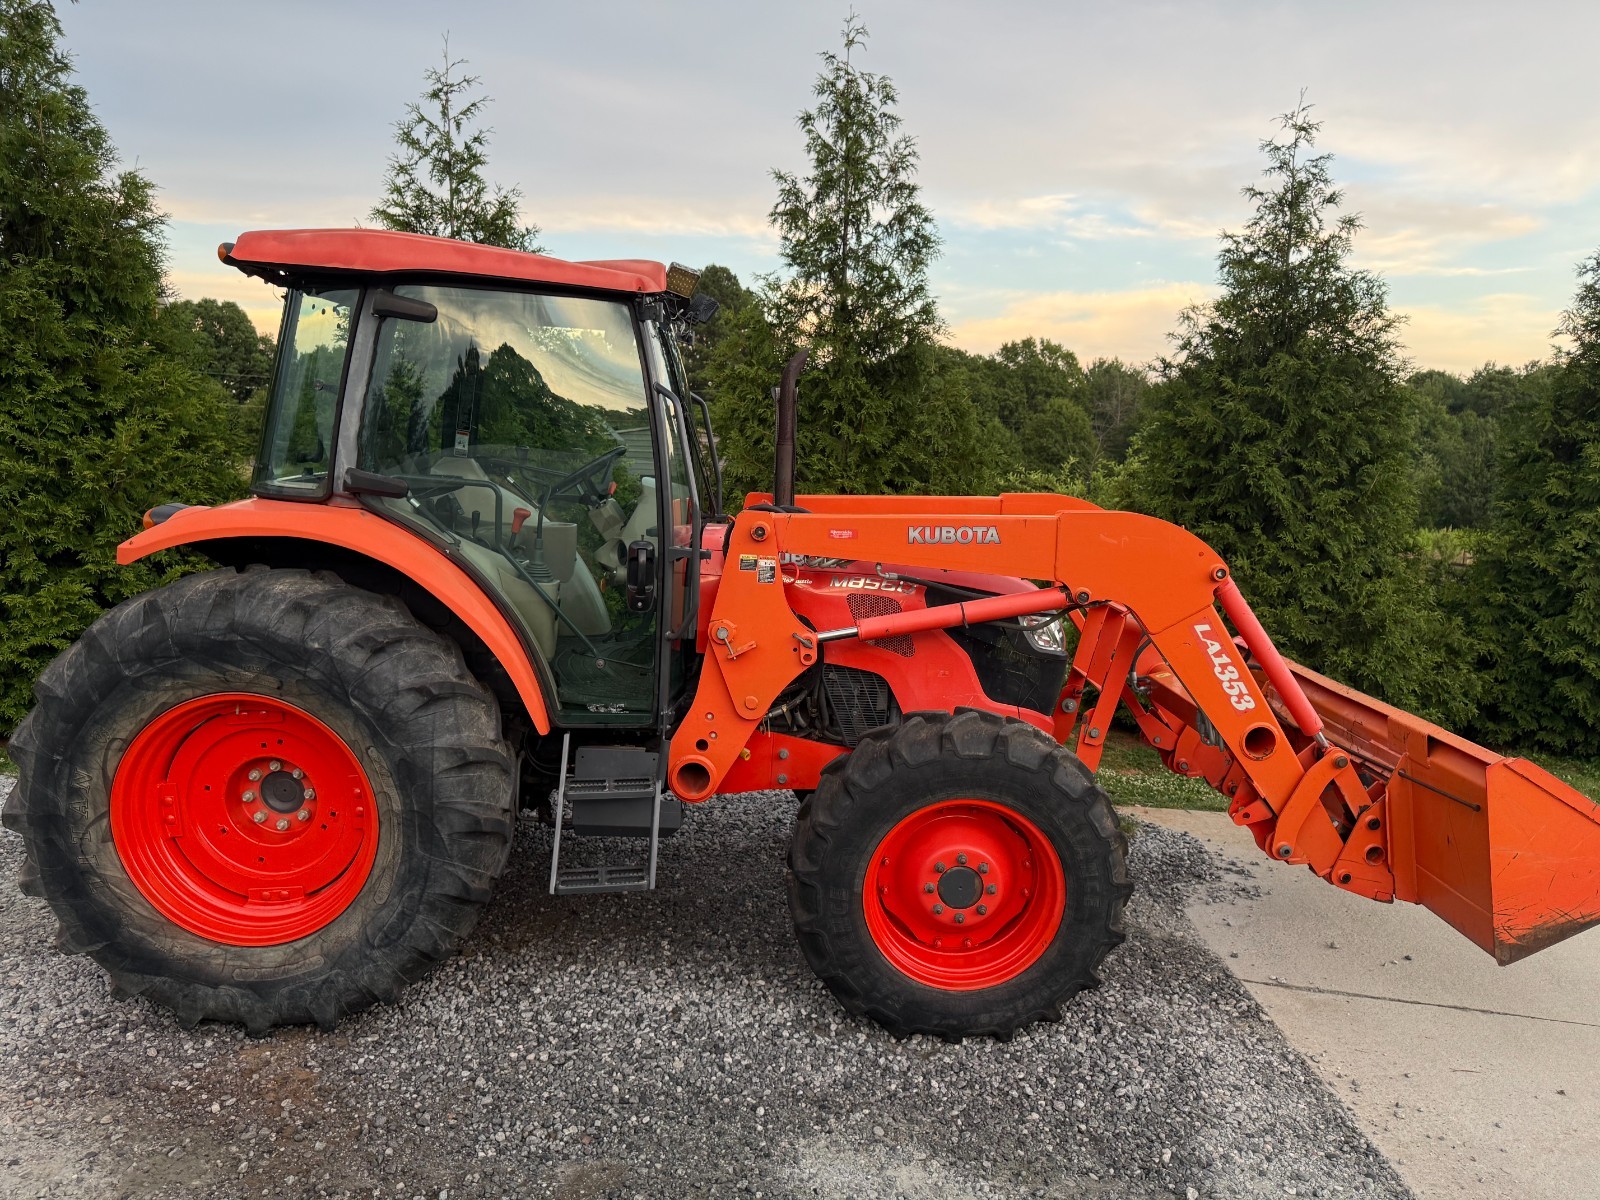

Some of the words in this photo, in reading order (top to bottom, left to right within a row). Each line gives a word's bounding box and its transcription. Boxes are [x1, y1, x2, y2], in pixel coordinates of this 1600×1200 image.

[908, 526, 1001, 544] KUBOTA
[1193, 624, 1256, 711] LA1353
[68, 767, 108, 894] TITAN
